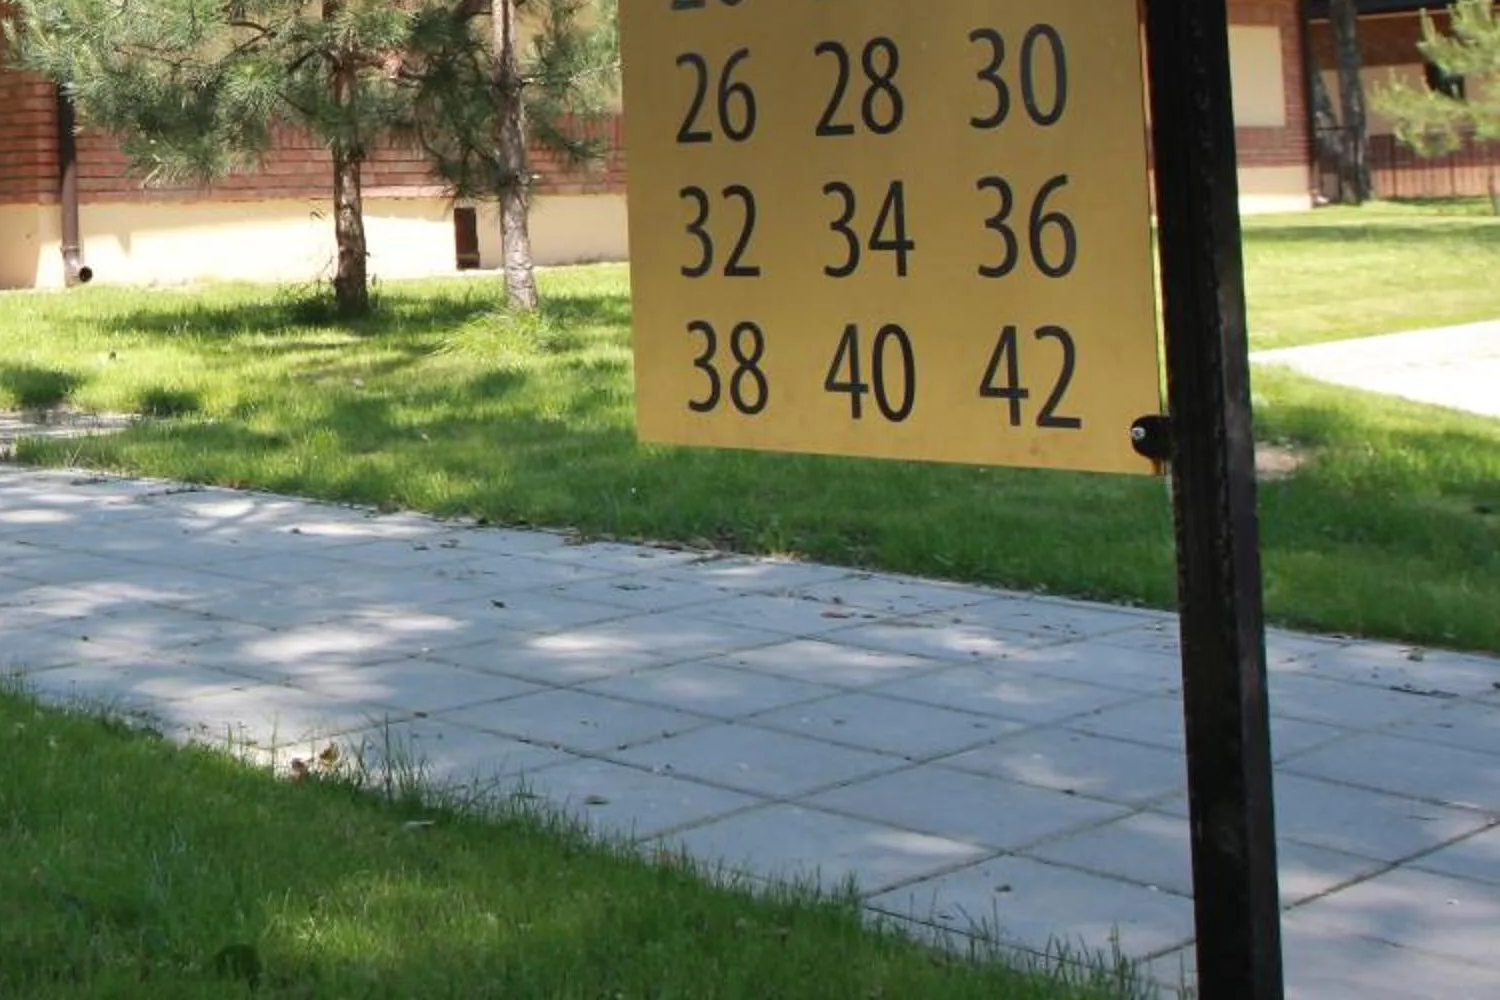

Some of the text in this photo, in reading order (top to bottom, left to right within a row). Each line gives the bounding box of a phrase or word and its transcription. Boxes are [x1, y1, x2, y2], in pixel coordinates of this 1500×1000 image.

[675, 23, 1068, 144] 26 28 30
[679, 173, 1077, 279] 32 34 36
[686, 319, 1082, 430] 38 40 42
